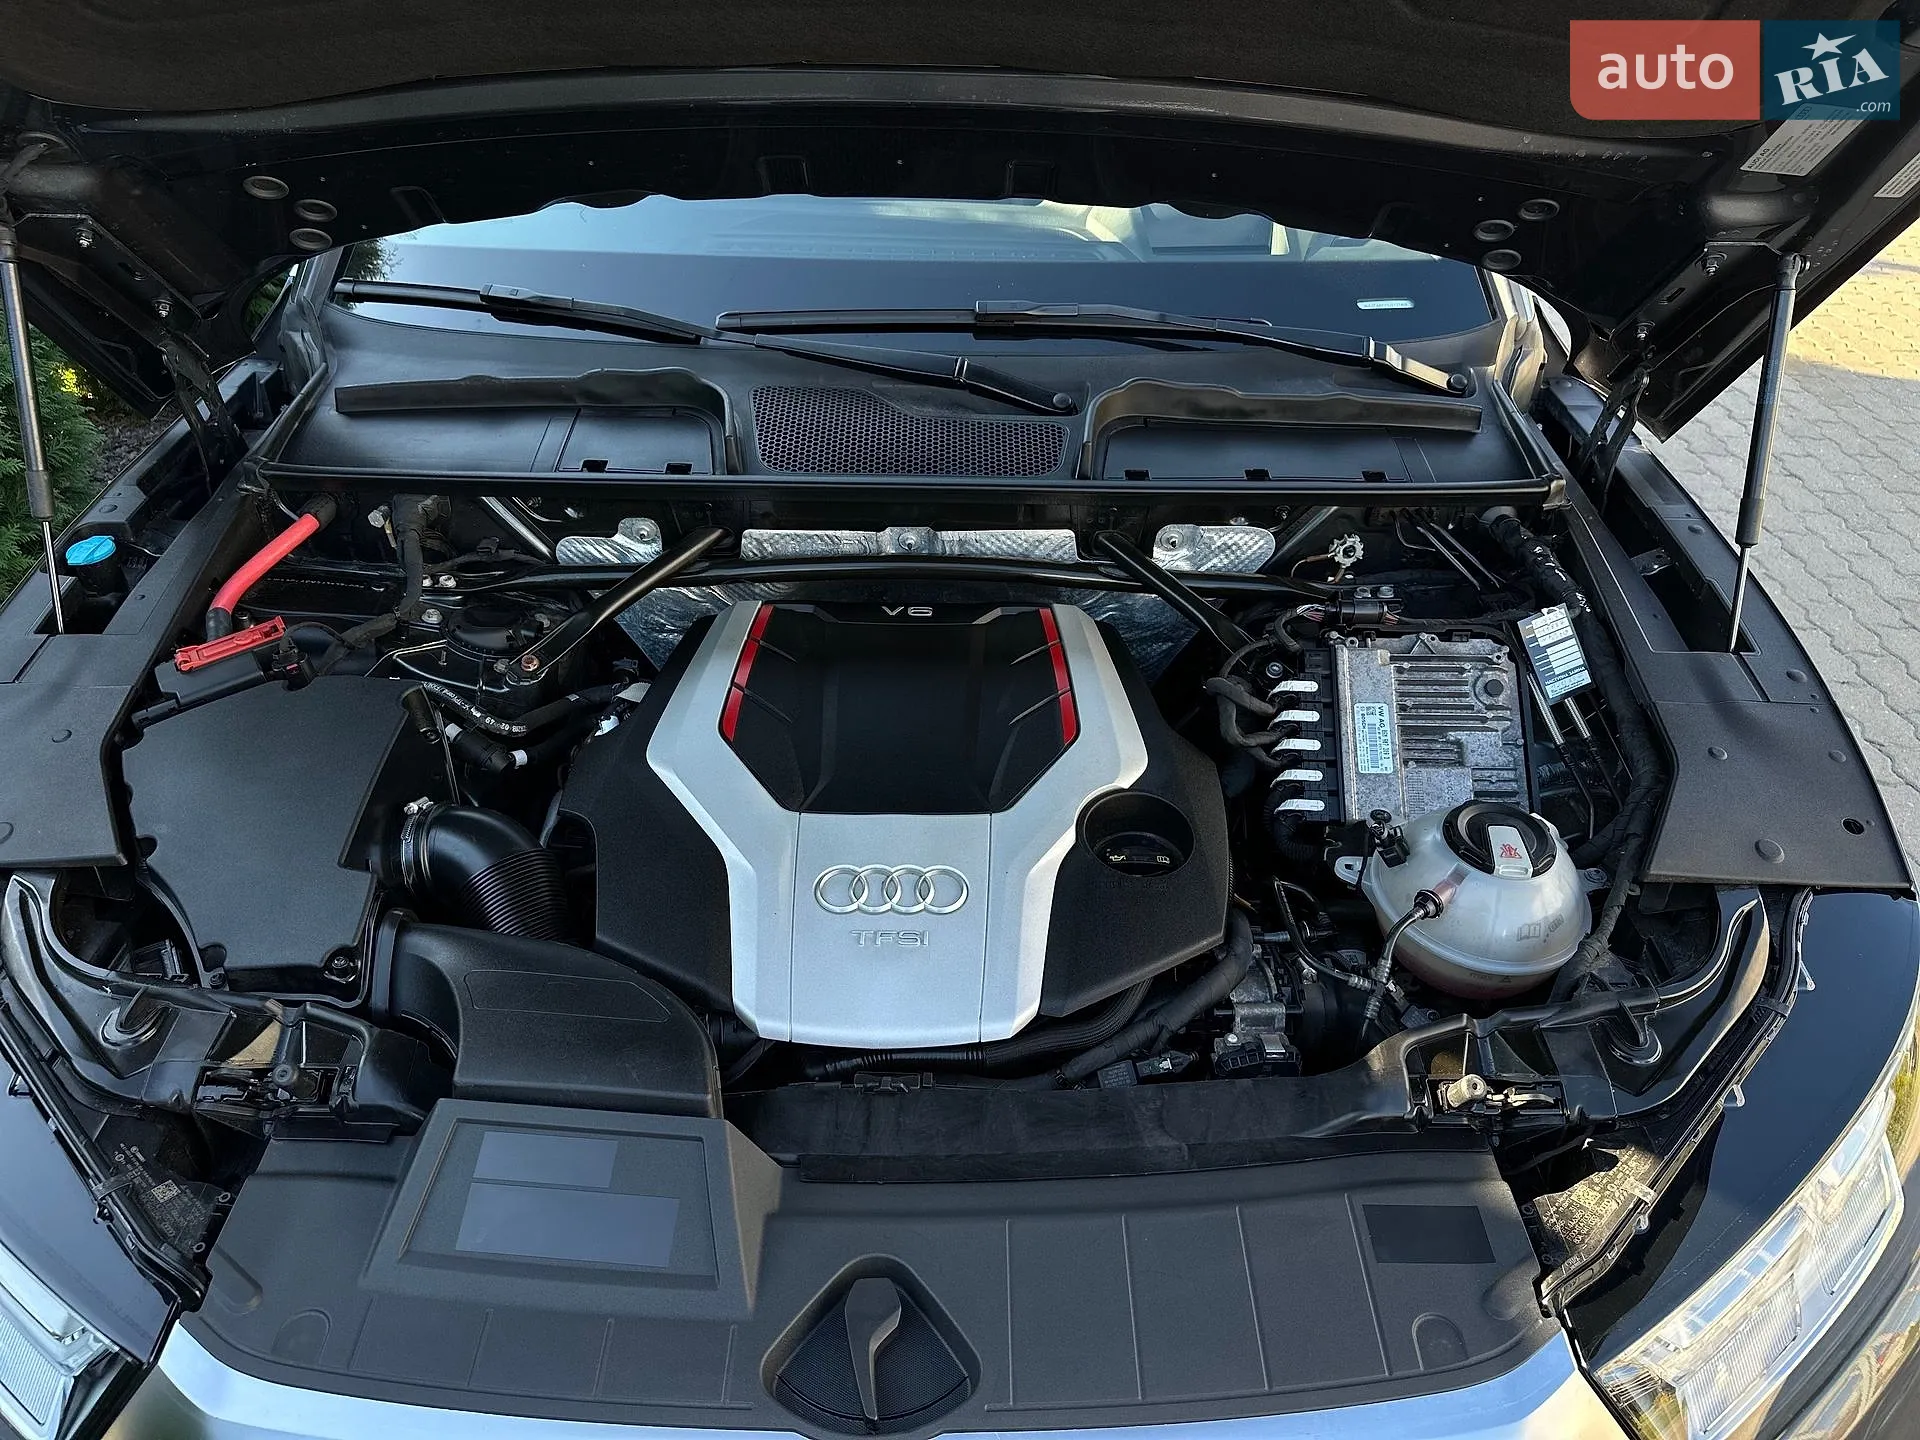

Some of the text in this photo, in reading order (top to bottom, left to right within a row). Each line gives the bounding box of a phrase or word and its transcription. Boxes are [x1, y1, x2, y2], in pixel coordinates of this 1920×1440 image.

[881, 605, 934, 618] V6
[1378, 705, 1385, 717] VW
[1378, 718, 1386, 729] AG
[850, 929, 929, 947] TFSI
